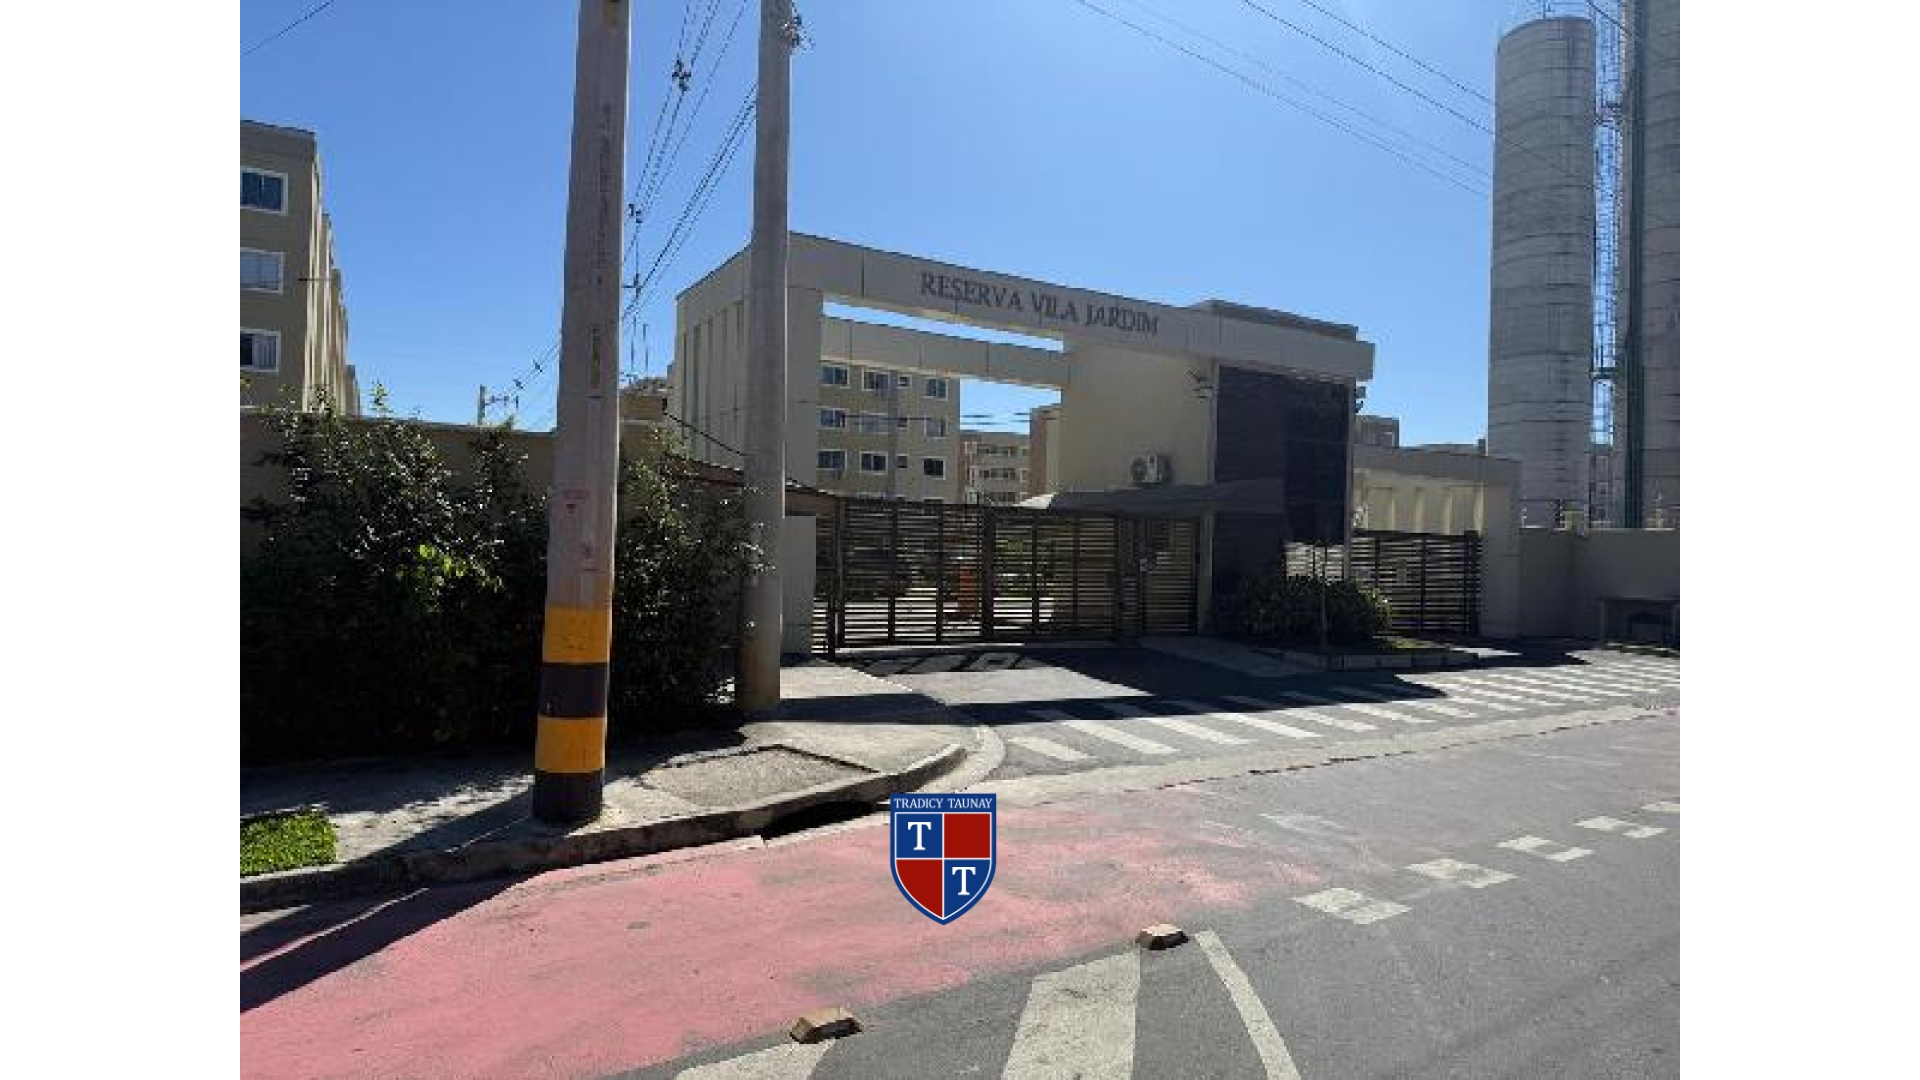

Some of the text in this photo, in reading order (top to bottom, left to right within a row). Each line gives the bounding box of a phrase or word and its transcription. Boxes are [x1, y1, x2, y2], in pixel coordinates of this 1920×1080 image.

[920, 271, 1160, 335] RESERVA VILA JARDIM
